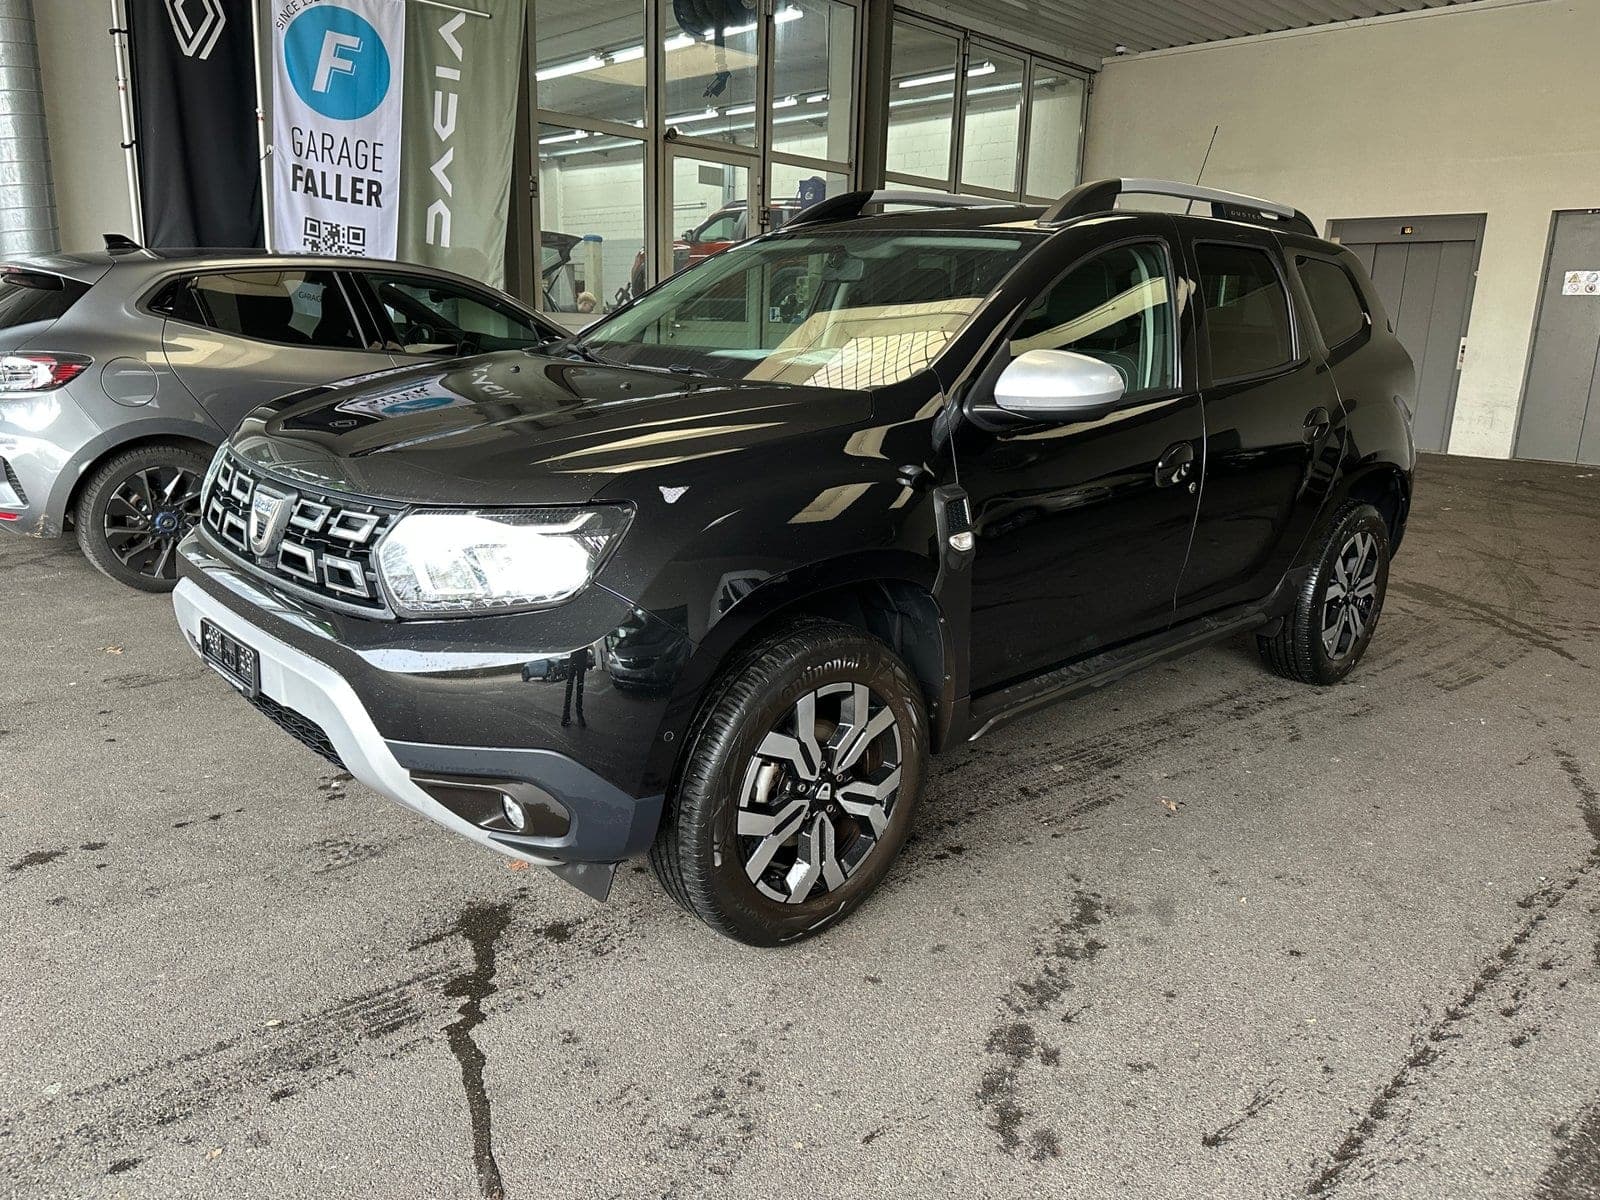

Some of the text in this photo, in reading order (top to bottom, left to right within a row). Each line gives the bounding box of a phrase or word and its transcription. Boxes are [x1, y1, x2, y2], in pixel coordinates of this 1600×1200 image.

[276, 0, 300, 30] SINCE
[312, 30, 363, 93] F
[291, 126, 383, 173] GARAGE
[291, 163, 382, 208] FALLER
